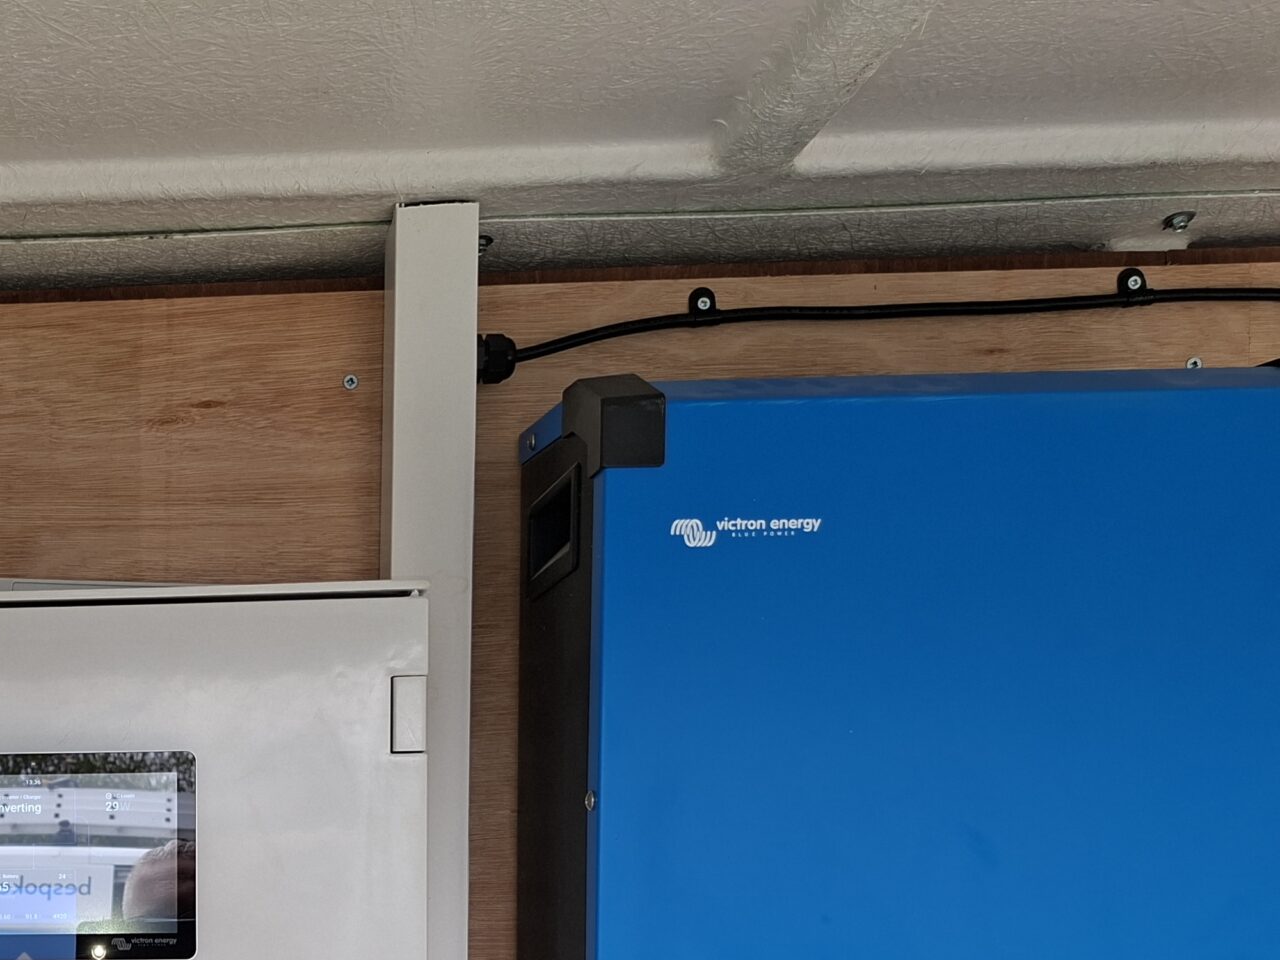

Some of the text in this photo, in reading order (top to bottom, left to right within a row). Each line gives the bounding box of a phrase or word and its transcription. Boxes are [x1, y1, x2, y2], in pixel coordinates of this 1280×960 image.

[716, 517, 822, 532] victron energy
[154, 937, 177, 945] energy
